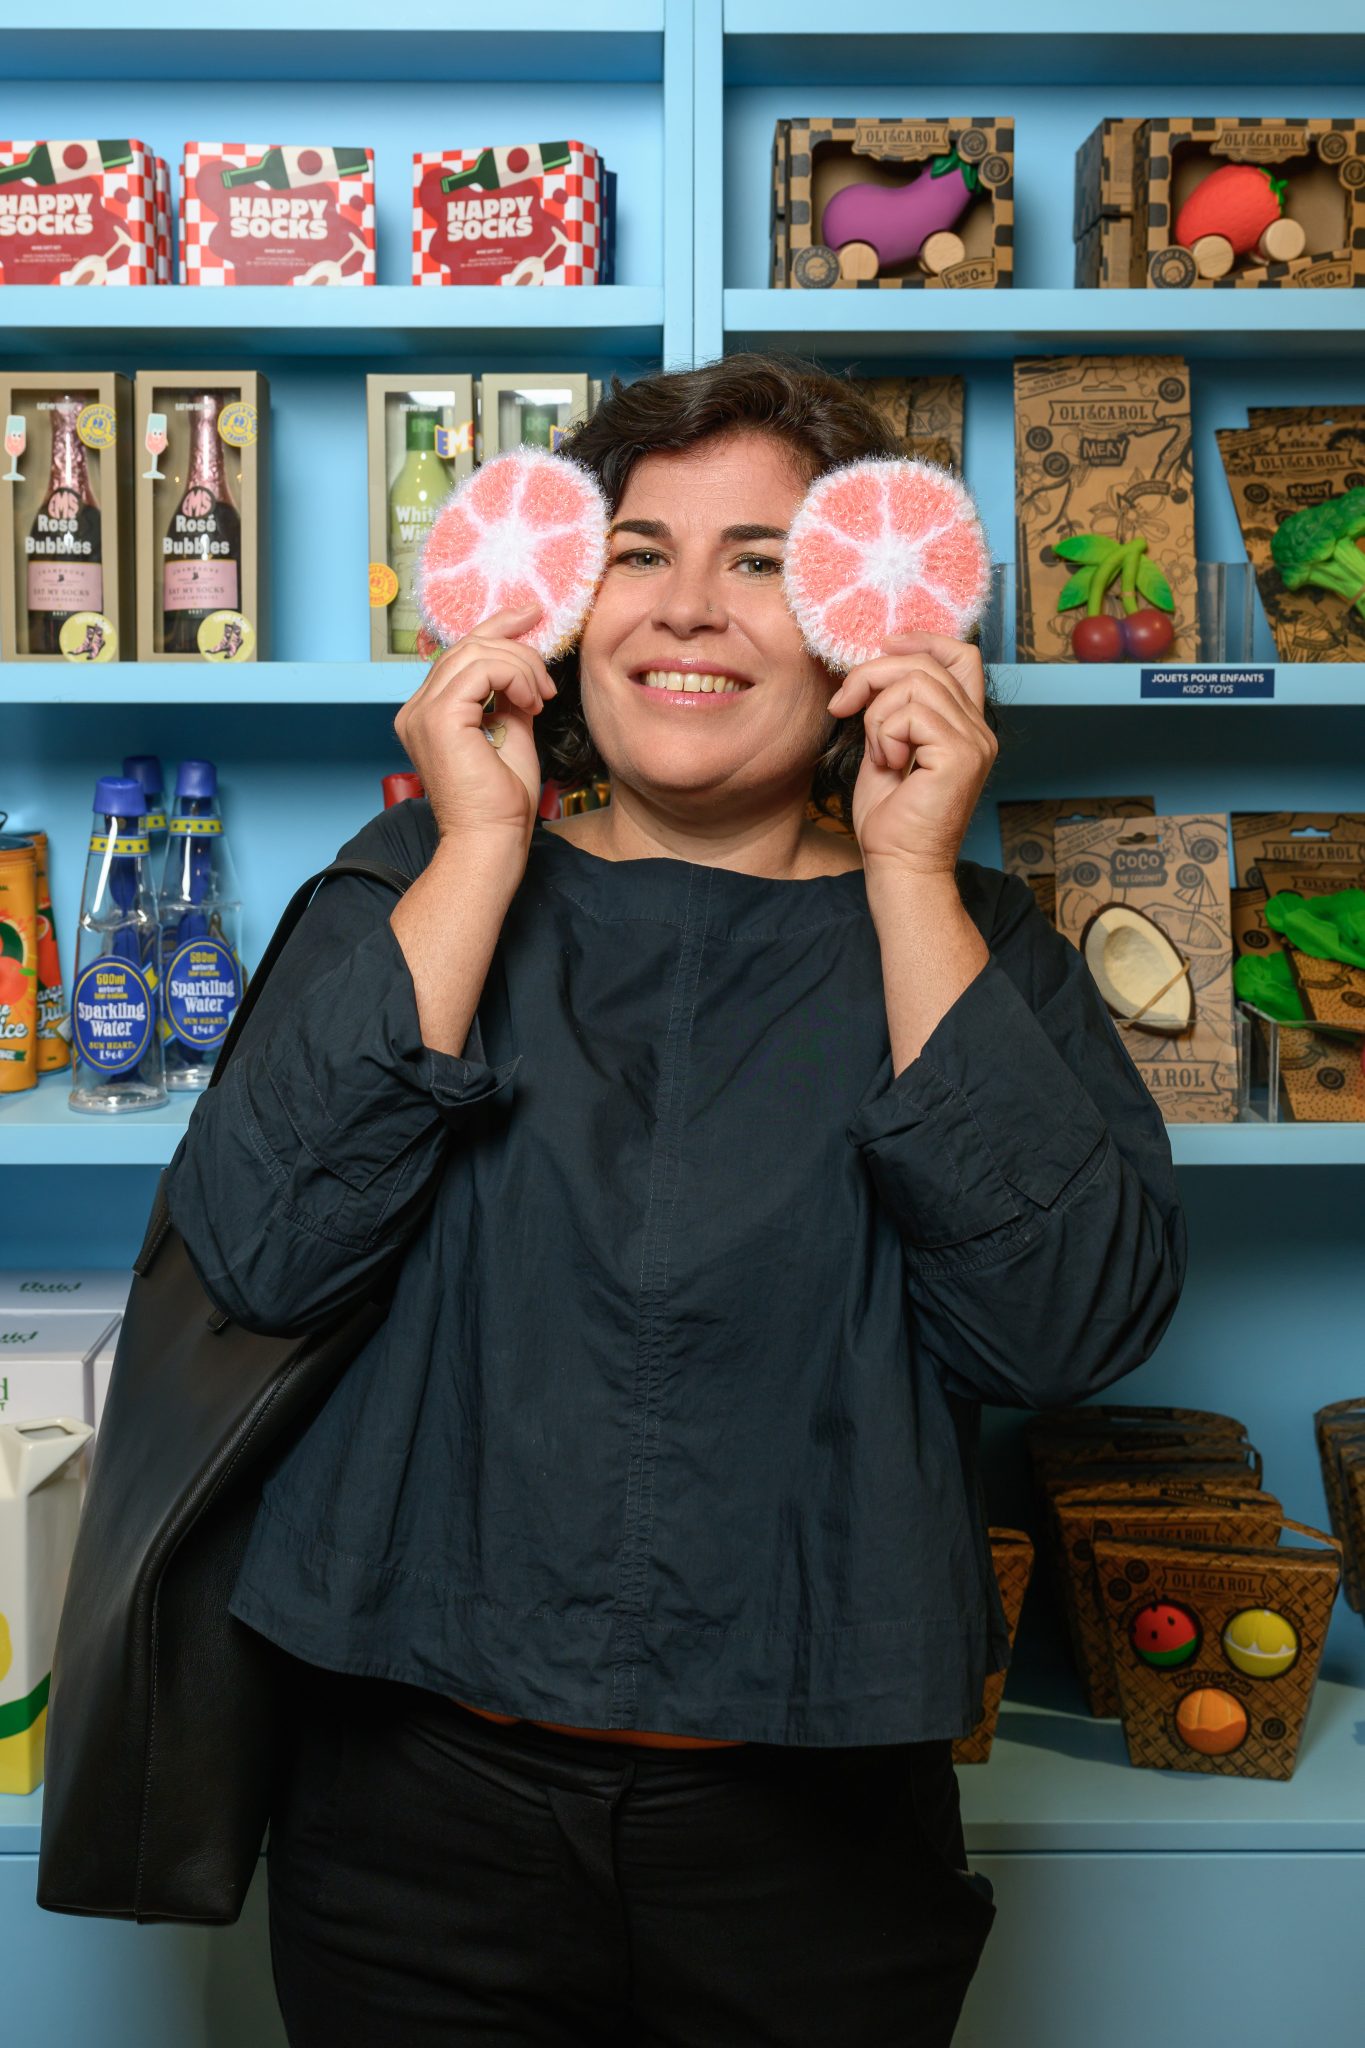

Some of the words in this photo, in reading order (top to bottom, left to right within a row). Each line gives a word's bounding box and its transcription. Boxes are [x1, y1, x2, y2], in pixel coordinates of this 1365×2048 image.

[0, 193, 93, 215] HAPPY
[229, 196, 328, 219] HAPPY
[447, 196, 533, 221] HAPPY
[0, 214, 93, 236] SOCKS
[230, 217, 328, 240] SOCKS
[447, 216, 533, 242] SOCKS
[175, 514, 217, 532] Rosé
[395, 505, 433, 523] Whit
[25, 536, 93, 555] Bubbles
[163, 536, 230, 555] Bubbles
[1152, 673, 1188, 683] JOUETS
[1191, 673, 1218, 683] POUR
[1220, 673, 1265, 683] ENFANTS
[1182, 684, 1207, 694] KIDS'
[1209, 684, 1234, 694] TOYS
[171, 979, 235, 999] Sparkling
[78, 1002, 146, 1021] Sparkling
[184, 996, 224, 1013] Water
[90, 1020, 132, 1037] Water
